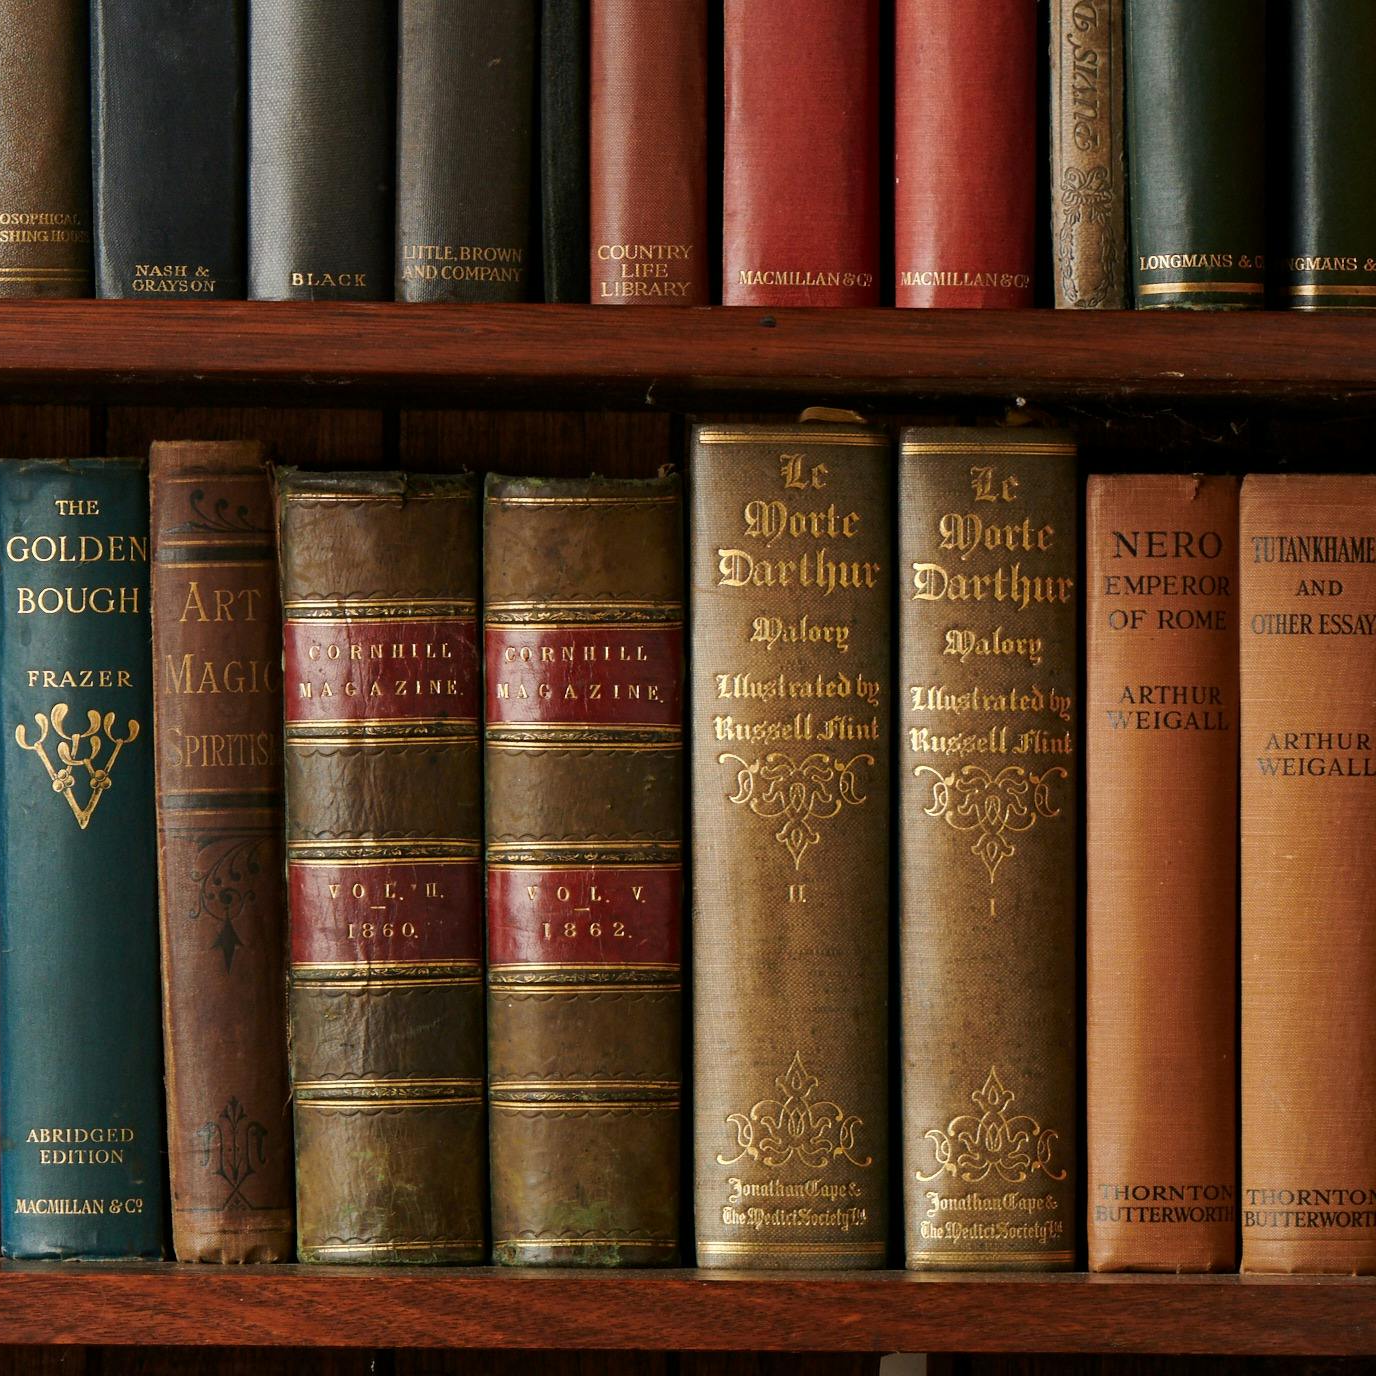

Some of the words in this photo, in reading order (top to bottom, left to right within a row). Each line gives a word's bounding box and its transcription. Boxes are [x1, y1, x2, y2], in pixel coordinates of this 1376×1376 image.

[460, 247, 522, 263] BROWN
[598, 245, 694, 260] COUNTRY
[621, 263, 668, 278] LIFE
[1140, 254, 1232, 270] LONGMANS
[135, 264, 188, 278] NASH
[195, 266, 210, 277] &
[402, 265, 439, 281] AND
[442, 266, 523, 283] COMPANY
[739, 269, 841, 286] MACMILLAN
[131, 279, 216, 293] GRAYSON
[292, 273, 367, 287] BLACK
[601, 281, 692, 297] LIBRARY
[779, 453, 829, 489] Le
[55, 500, 99, 515] THE
[744, 501, 860, 547] Morte
[6, 536, 147, 562] GOLDEN
[1112, 532, 1223, 558] NERO
[718, 548, 881, 596] Darthur
[1105, 576, 1231, 596] EMPEROR
[1295, 580, 1343, 596] AND
[16, 588, 139, 614] BOUGH
[1109, 610, 1147, 630] OF
[1158, 610, 1226, 630] ROME
[1251, 614, 1314, 635] OTHER
[751, 615, 849, 652] Malory
[309, 644, 452, 661] CORNHILL
[27, 670, 133, 687] FRAZER
[300, 680, 463, 699] MAGAZINE.
[856, 679, 880, 705] by
[348, 922, 418, 940] 1860.
[26, 1128, 134, 1144] ABRIDGED
[40, 1150, 124, 1165] EDITION
